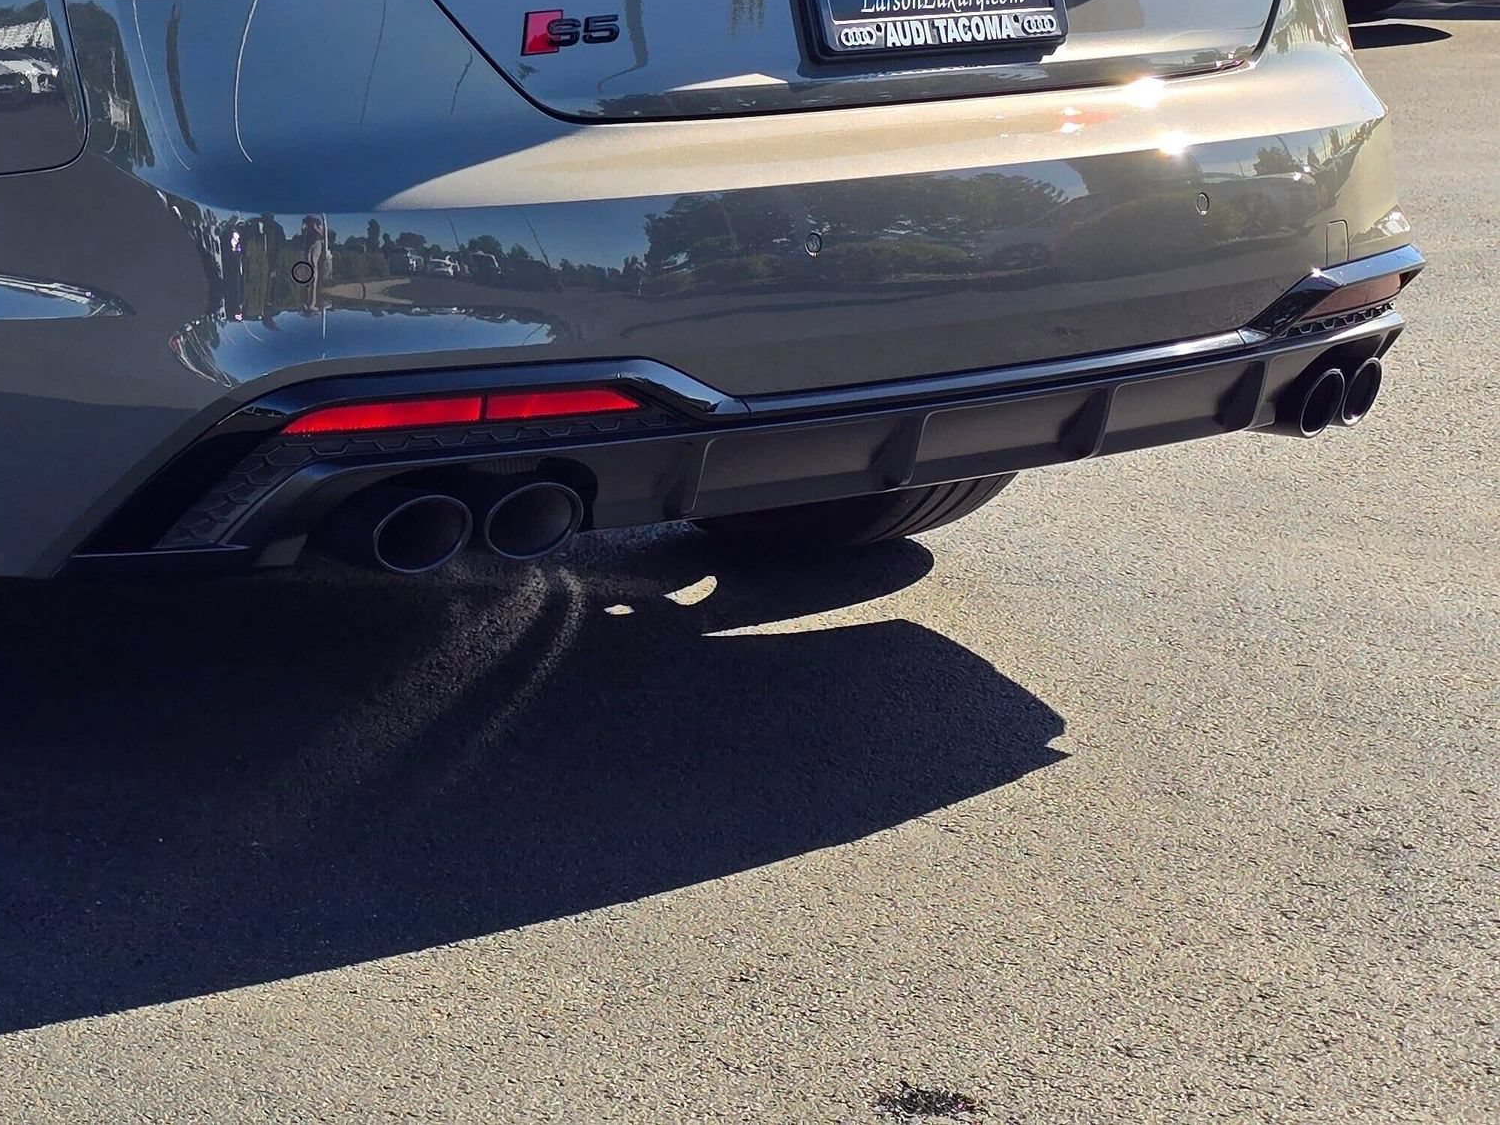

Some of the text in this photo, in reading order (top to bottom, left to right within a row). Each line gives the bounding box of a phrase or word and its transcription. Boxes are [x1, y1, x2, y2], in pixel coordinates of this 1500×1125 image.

[547, 14, 620, 47] S5
[886, 14, 1016, 48] AUDI TACOMA
